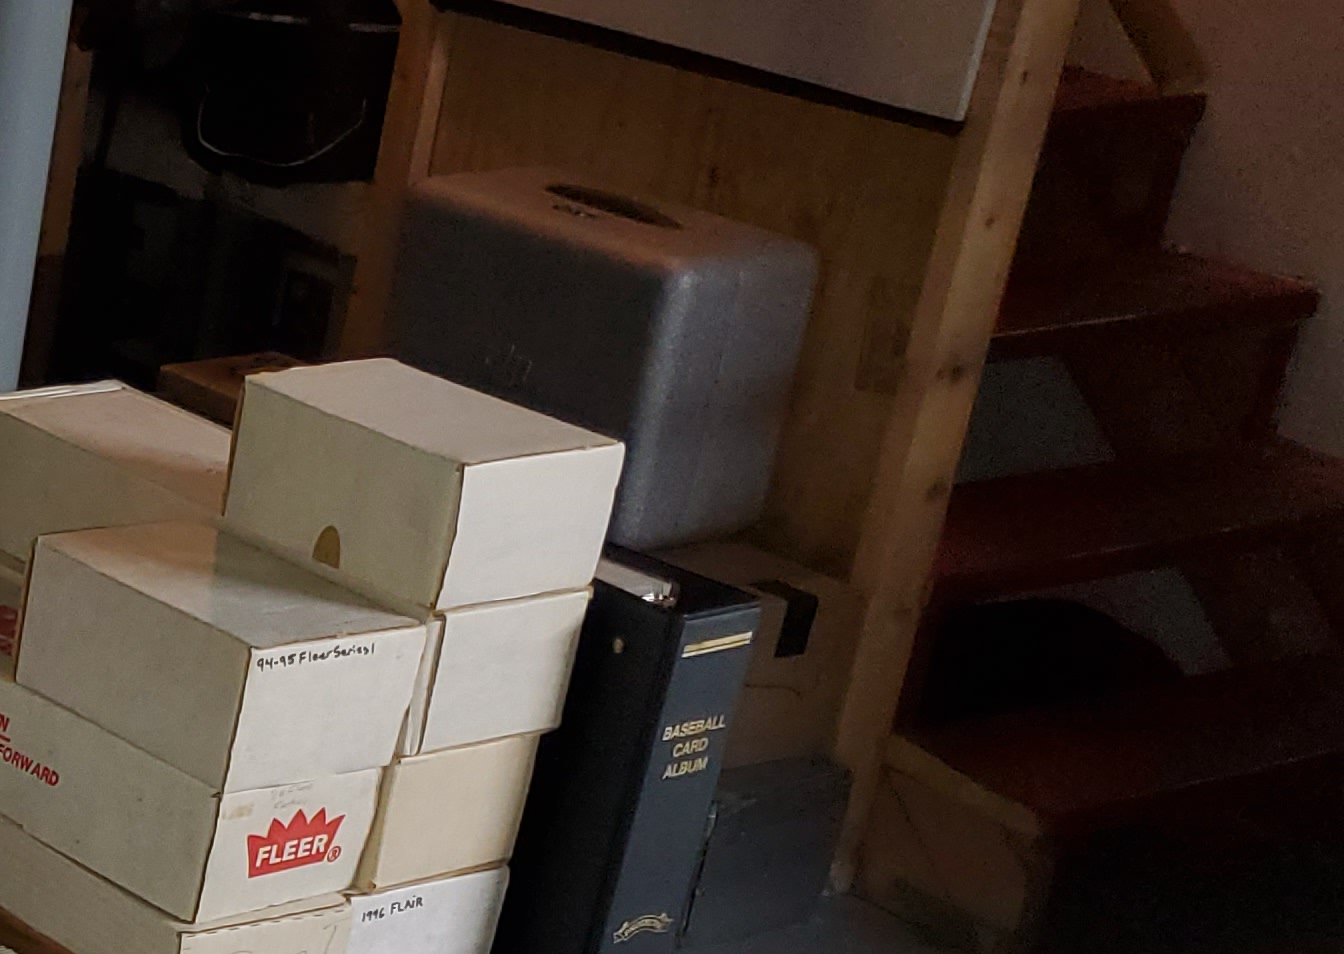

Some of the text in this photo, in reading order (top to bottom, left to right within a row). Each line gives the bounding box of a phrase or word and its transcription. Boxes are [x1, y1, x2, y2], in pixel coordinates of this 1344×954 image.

[661, 714, 726, 741] BASEBALL
[672, 737, 709, 758] CARD
[661, 755, 709, 780] ALBUM
[255, 833, 329, 869] FLEER
[361, 907, 385, 923] 1996
